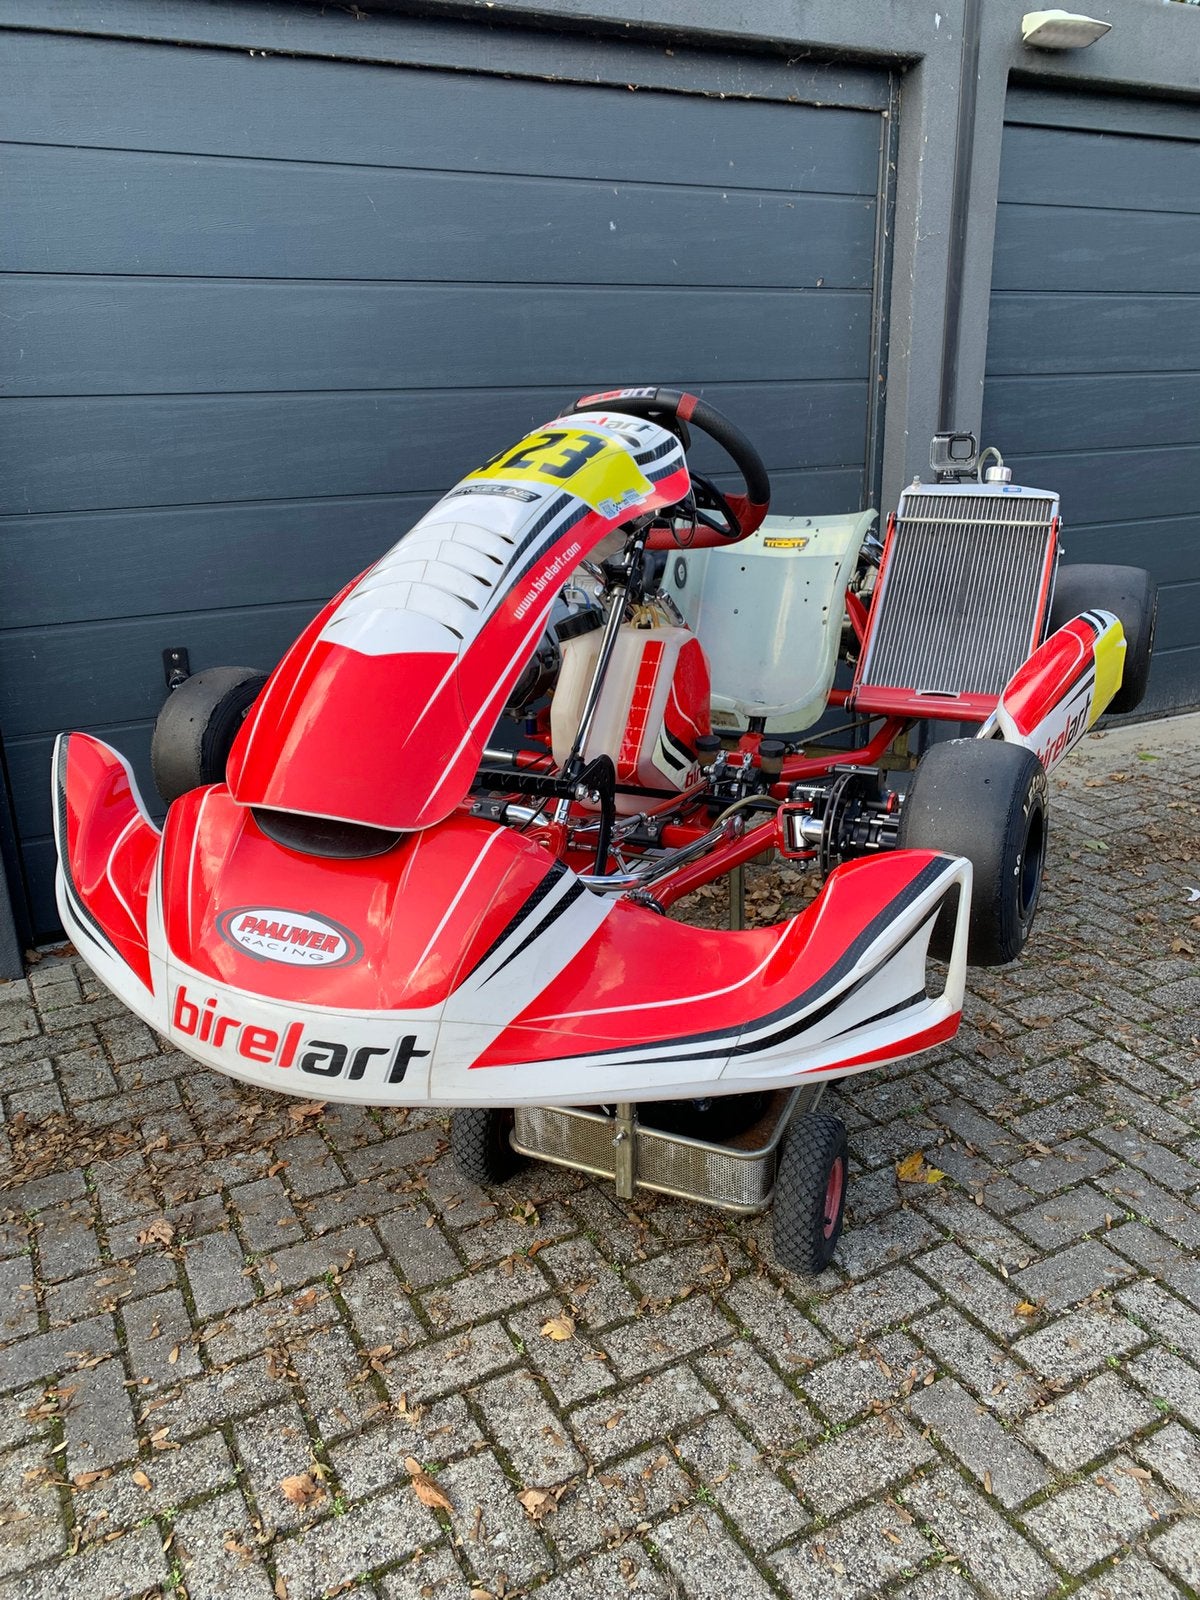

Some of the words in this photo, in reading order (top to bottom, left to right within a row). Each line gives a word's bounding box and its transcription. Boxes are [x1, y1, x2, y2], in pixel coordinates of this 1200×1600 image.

[479, 432, 608, 479] 23
[513, 542, 581, 620] www.birelart.com
[237, 915, 341, 954] PAAUWER
[240, 935, 325, 961] RACING
[173, 985, 431, 1084] birelart
